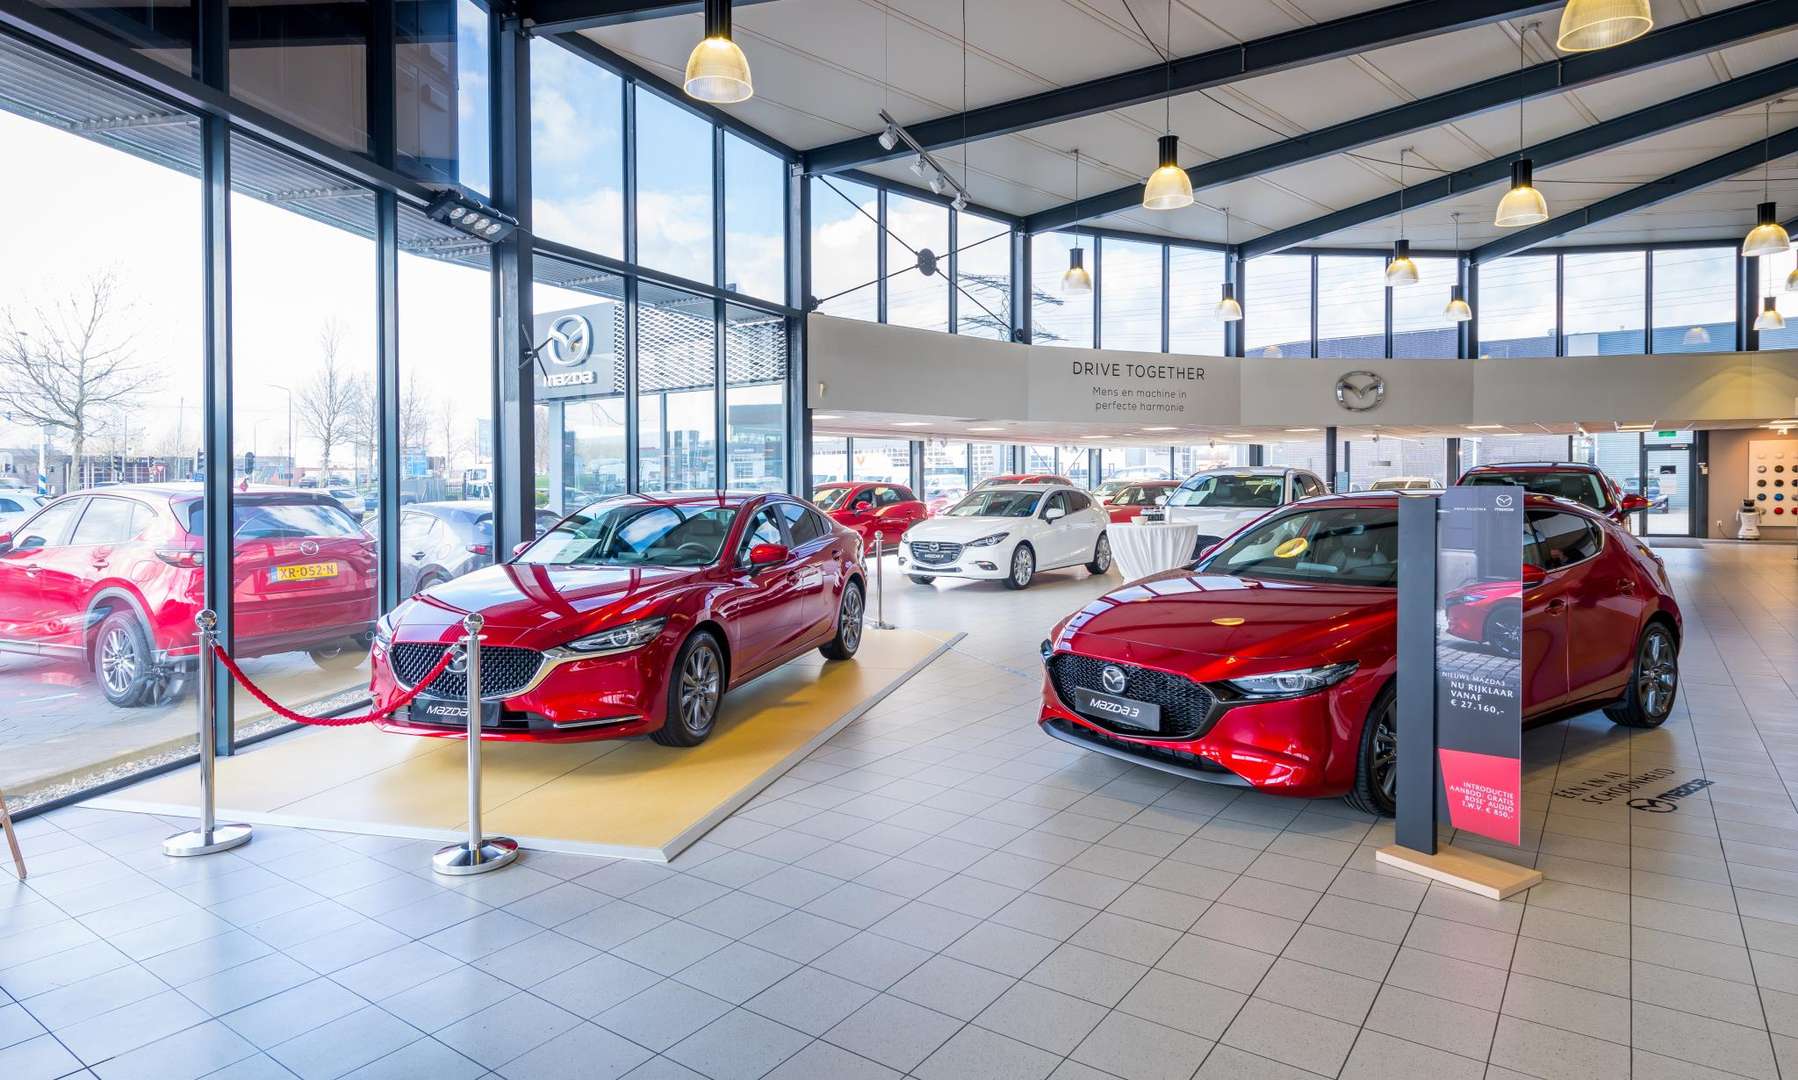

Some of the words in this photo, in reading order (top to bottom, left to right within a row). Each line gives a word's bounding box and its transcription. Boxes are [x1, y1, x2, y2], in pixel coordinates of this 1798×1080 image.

[1072, 361, 1120, 377] DRIVE
[1126, 364, 1205, 380] TOGETHER
[1092, 386, 1119, 397] Mens
[1121, 388, 1134, 397] en
[1136, 388, 1176, 399] machine
[1178, 389, 1187, 399] in
[1095, 400, 1137, 412] perfecte
[1140, 401, 1184, 412] harmonie
[1450, 681, 1465, 689] NU
[1468, 683, 1514, 698] RIJKLAAR
[1450, 690, 1482, 701] VANAF
[1463, 782, 1514, 799] INTRODUCTIE
[1486, 794, 1514, 806] GRATIS
[1488, 801, 1514, 813] AUDIO
